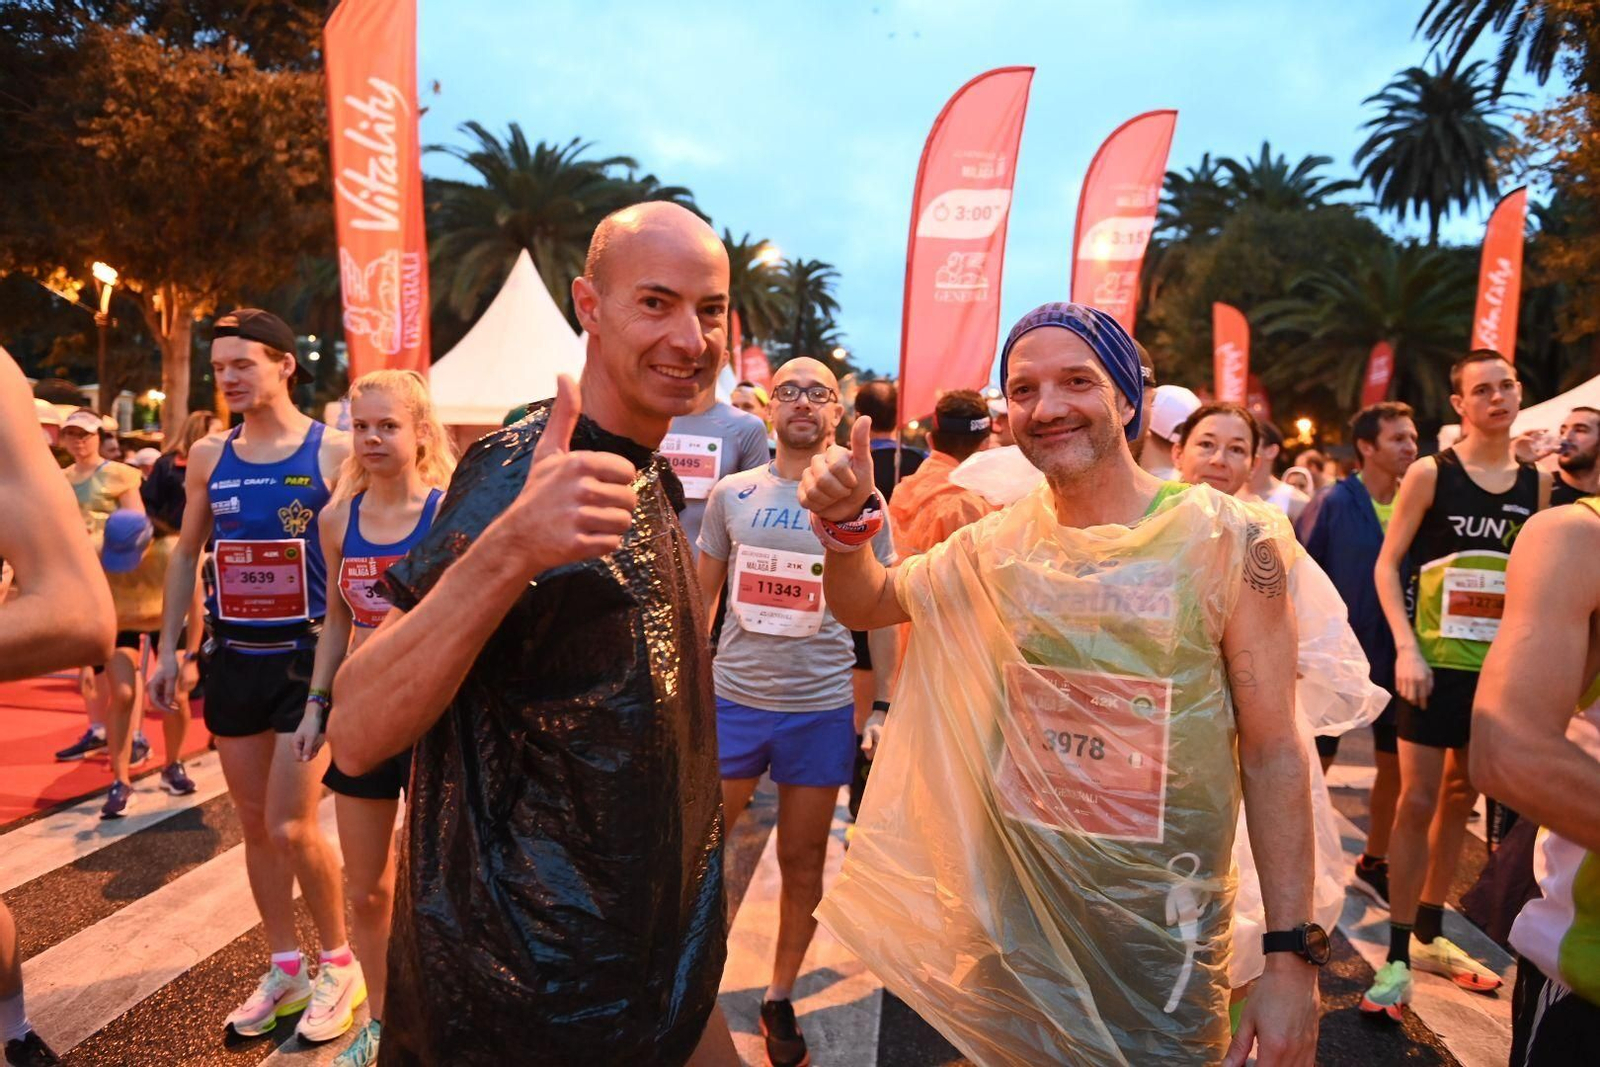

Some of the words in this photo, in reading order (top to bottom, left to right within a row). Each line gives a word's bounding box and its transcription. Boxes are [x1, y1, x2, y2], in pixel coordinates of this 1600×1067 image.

[335, 77, 411, 231] Vitality
[955, 205, 991, 221] 3:00
[284, 477, 311, 486] PART
[751, 507, 812, 531] ITAL
[787, 562, 803, 570] 21K
[240, 571, 275, 584] 3639
[758, 580, 802, 598] 11343
[1042, 728, 1105, 760] 3978
